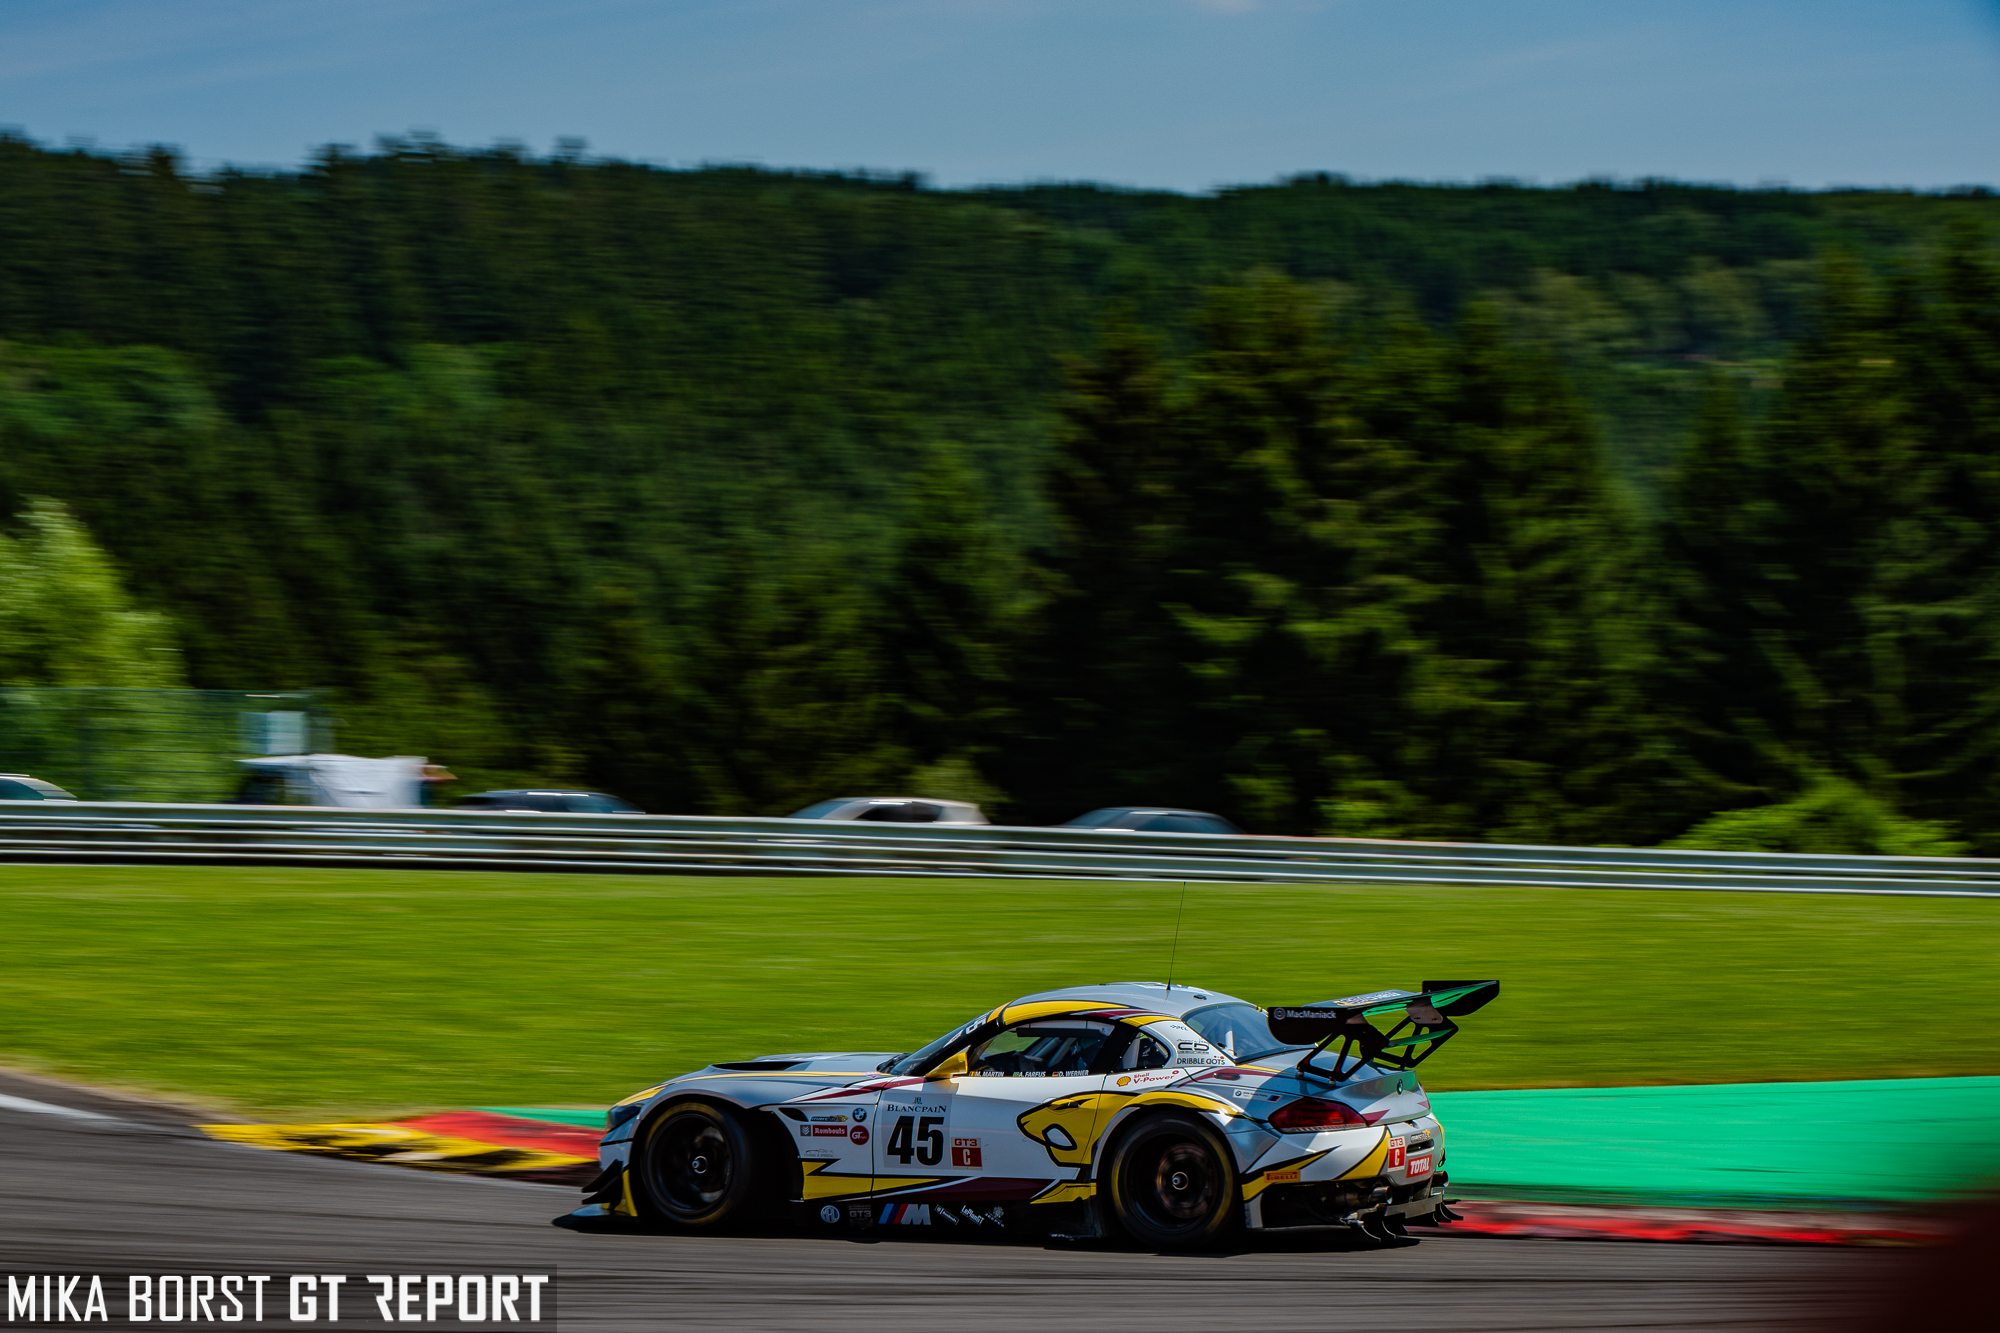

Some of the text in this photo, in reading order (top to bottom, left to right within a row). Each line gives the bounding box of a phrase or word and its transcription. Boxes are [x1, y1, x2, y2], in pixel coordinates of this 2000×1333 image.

[1286, 1010, 1337, 1019] MacManiack
[1176, 1057, 1205, 1065] DRIBBLE
[1133, 1075, 1175, 1084] V-Power
[887, 1104, 948, 1113] BLANCPAIN
[814, 1127, 846, 1135] Rombouts
[887, 1115, 945, 1166] 45
[954, 1138, 978, 1147] GT3
[1389, 1137, 1404, 1148] GT3
[962, 1148, 971, 1166] C
[1394, 1148, 1400, 1166] C
[1410, 1157, 1430, 1175] TOTAL
[1266, 1171, 1298, 1181] PIRELLI
